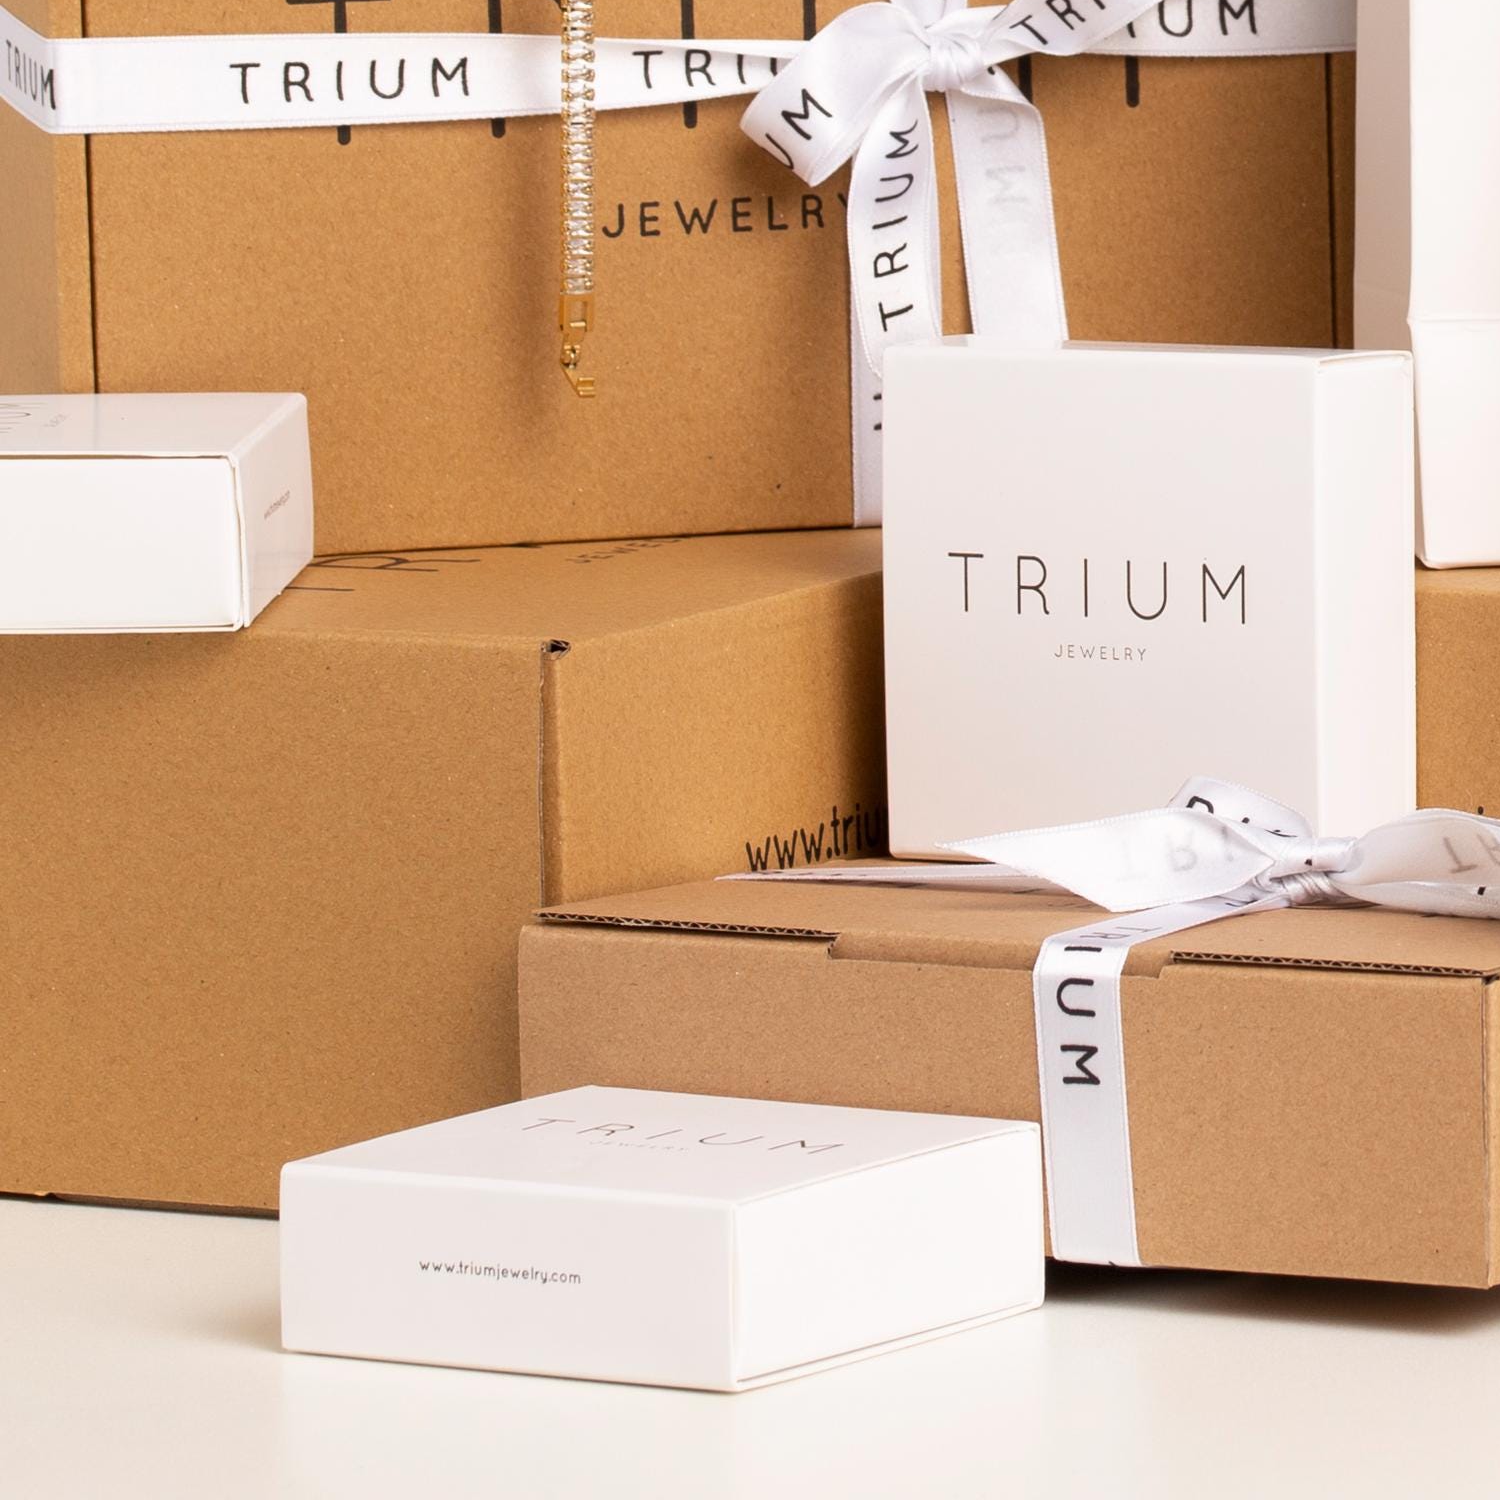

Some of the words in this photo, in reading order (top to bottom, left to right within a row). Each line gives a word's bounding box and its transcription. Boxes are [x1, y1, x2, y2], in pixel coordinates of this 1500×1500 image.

[5, 39, 57, 110] TRIUM
[228, 55, 471, 105] TRIUM
[631, 48, 778, 89] TRI
[601, 192, 847, 240] JEWELR
[872, 118, 919, 333] TRIUM
[947, 551, 1247, 625] TRIUM
[1053, 643, 1148, 661] JEWELRY
[521, 1117, 845, 1155] TRIUM
[418, 1260, 582, 1285] www.triumjewelry.com
